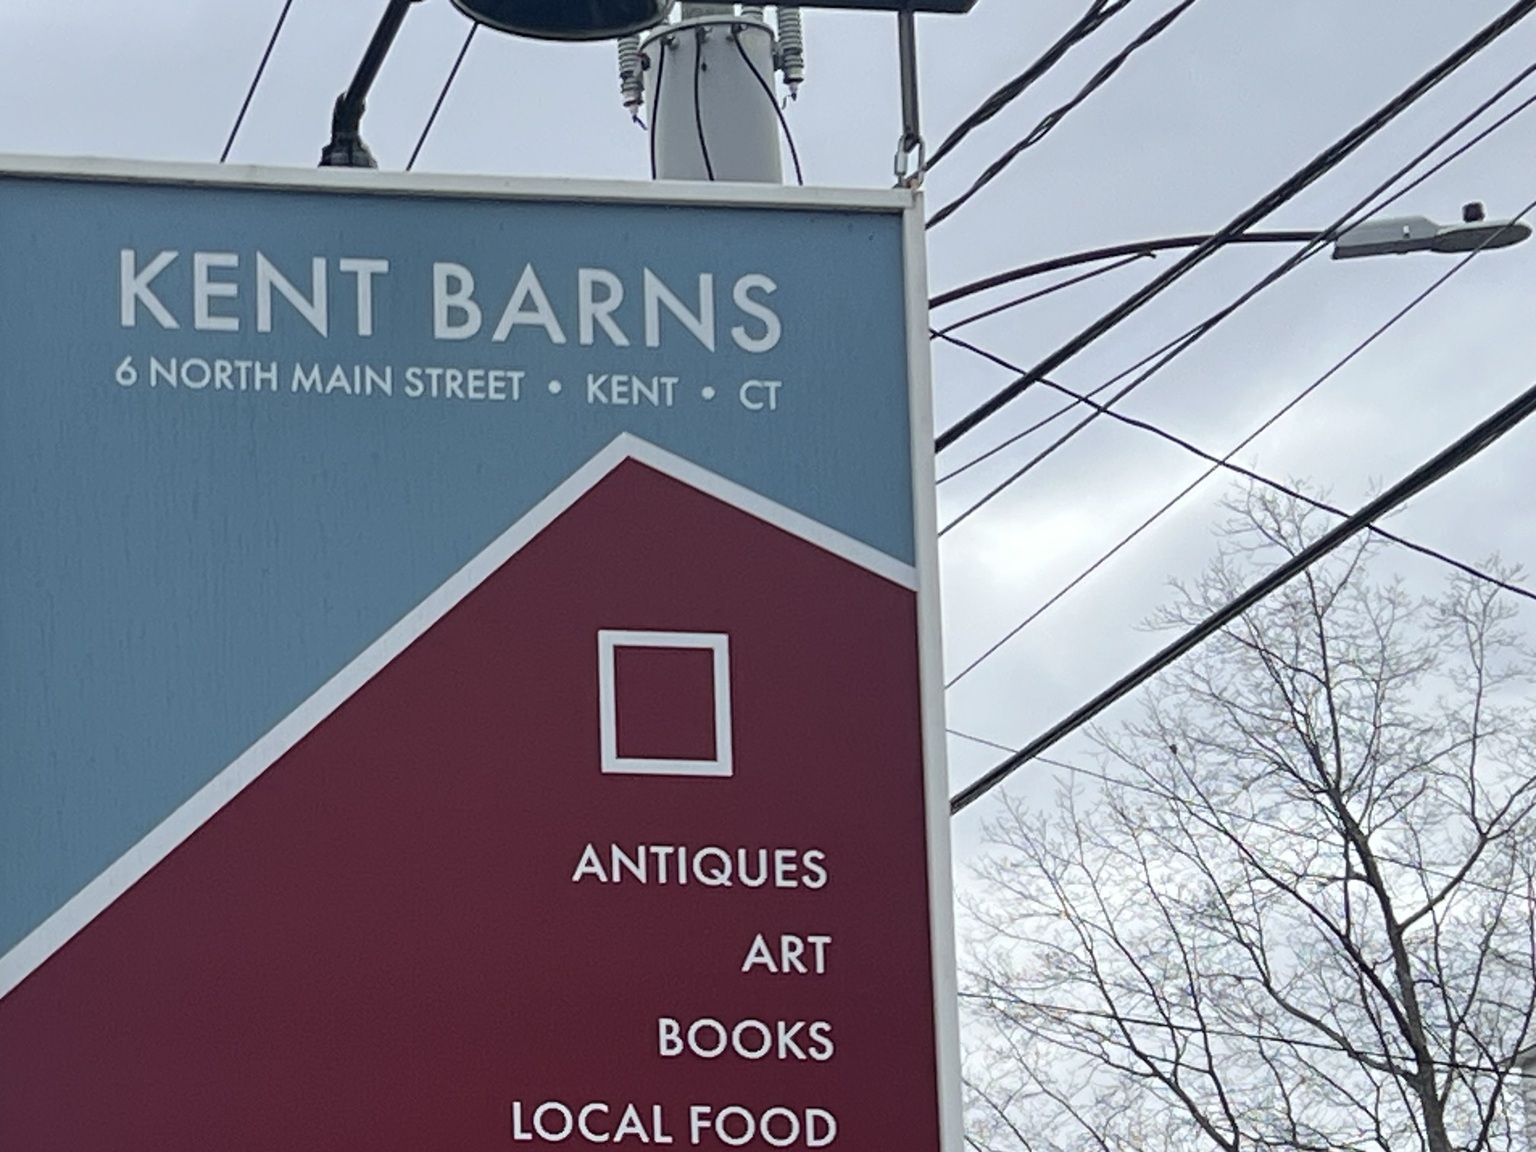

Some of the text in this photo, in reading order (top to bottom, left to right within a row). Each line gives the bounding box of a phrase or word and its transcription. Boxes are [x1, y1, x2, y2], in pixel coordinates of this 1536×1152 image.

[121, 250, 780, 352] KENT BARNS
[116, 357, 781, 409] 6 NORTH MAIN STREET KENT CT
[573, 844, 826, 888] ANTIQUES
[742, 934, 831, 973] ART
[659, 1018, 833, 1060] BOOKS
[513, 1102, 836, 1146] LOCAL FOOD
